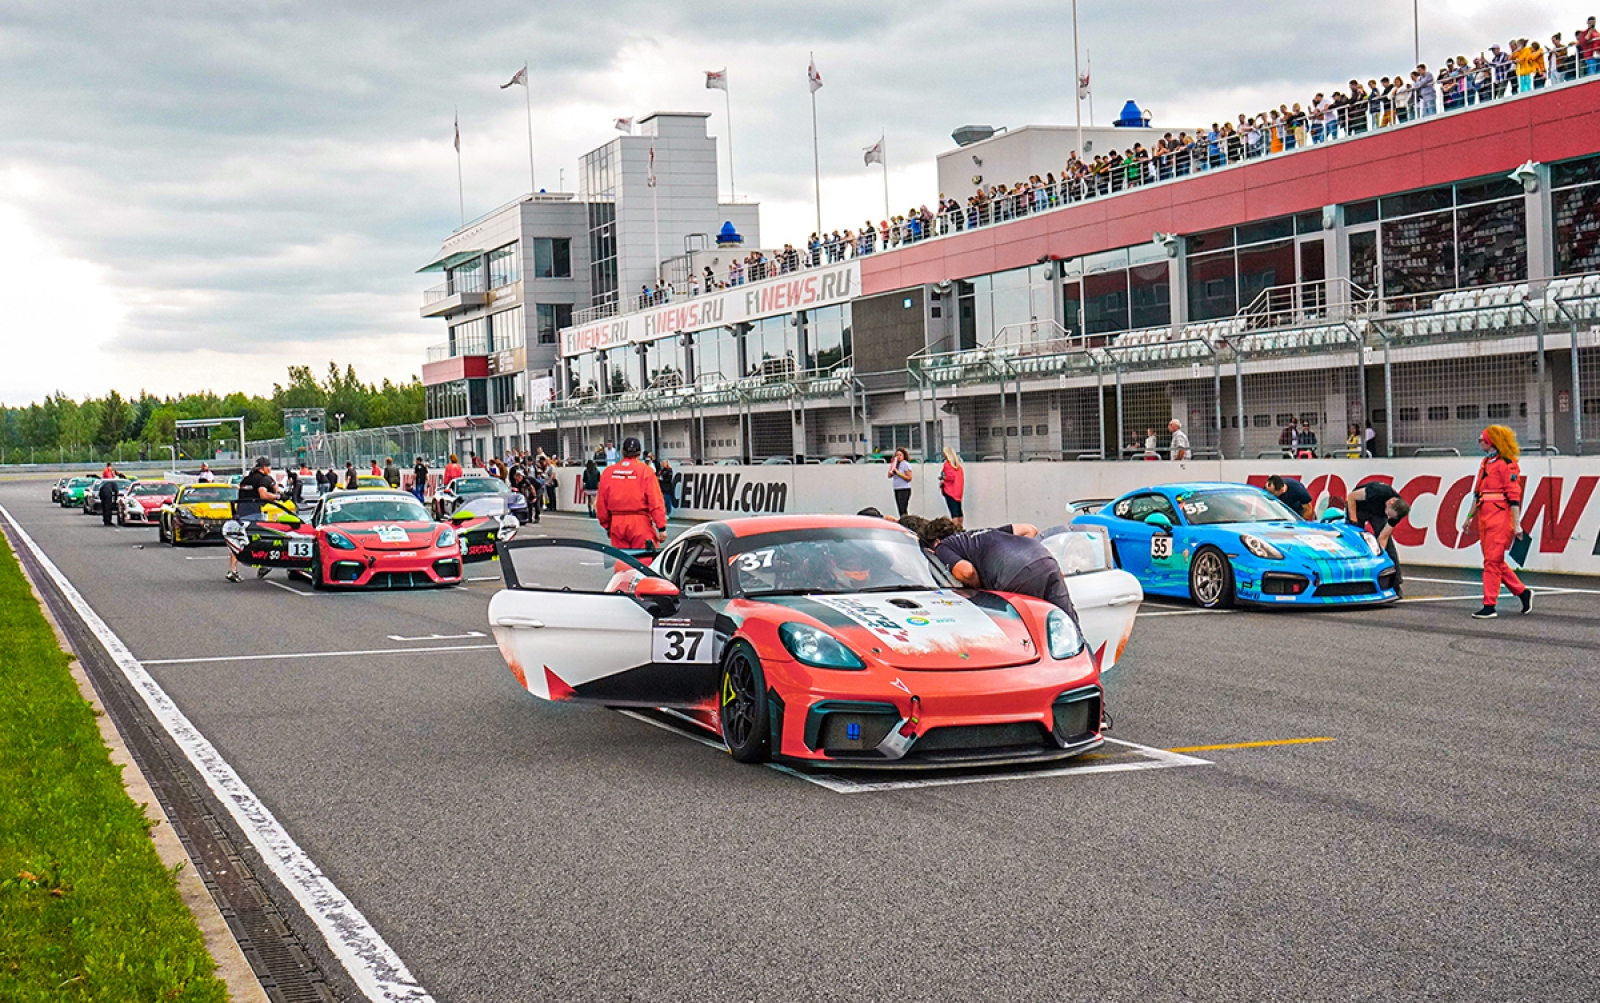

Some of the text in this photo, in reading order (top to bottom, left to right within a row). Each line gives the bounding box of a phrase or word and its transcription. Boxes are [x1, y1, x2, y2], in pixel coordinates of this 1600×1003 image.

[745, 268, 852, 316] F1NEWS.RU
[644, 298, 724, 336] F1NEWS.RU
[567, 320, 629, 352] F1NEWS.RU
[671, 472, 788, 513] CEWAY.com
[1183, 501, 1209, 515] 55
[293, 543, 309, 556] 13
[738, 549, 776, 572] 37
[1154, 538, 1168, 554] 55
[663, 630, 705, 661] 37
